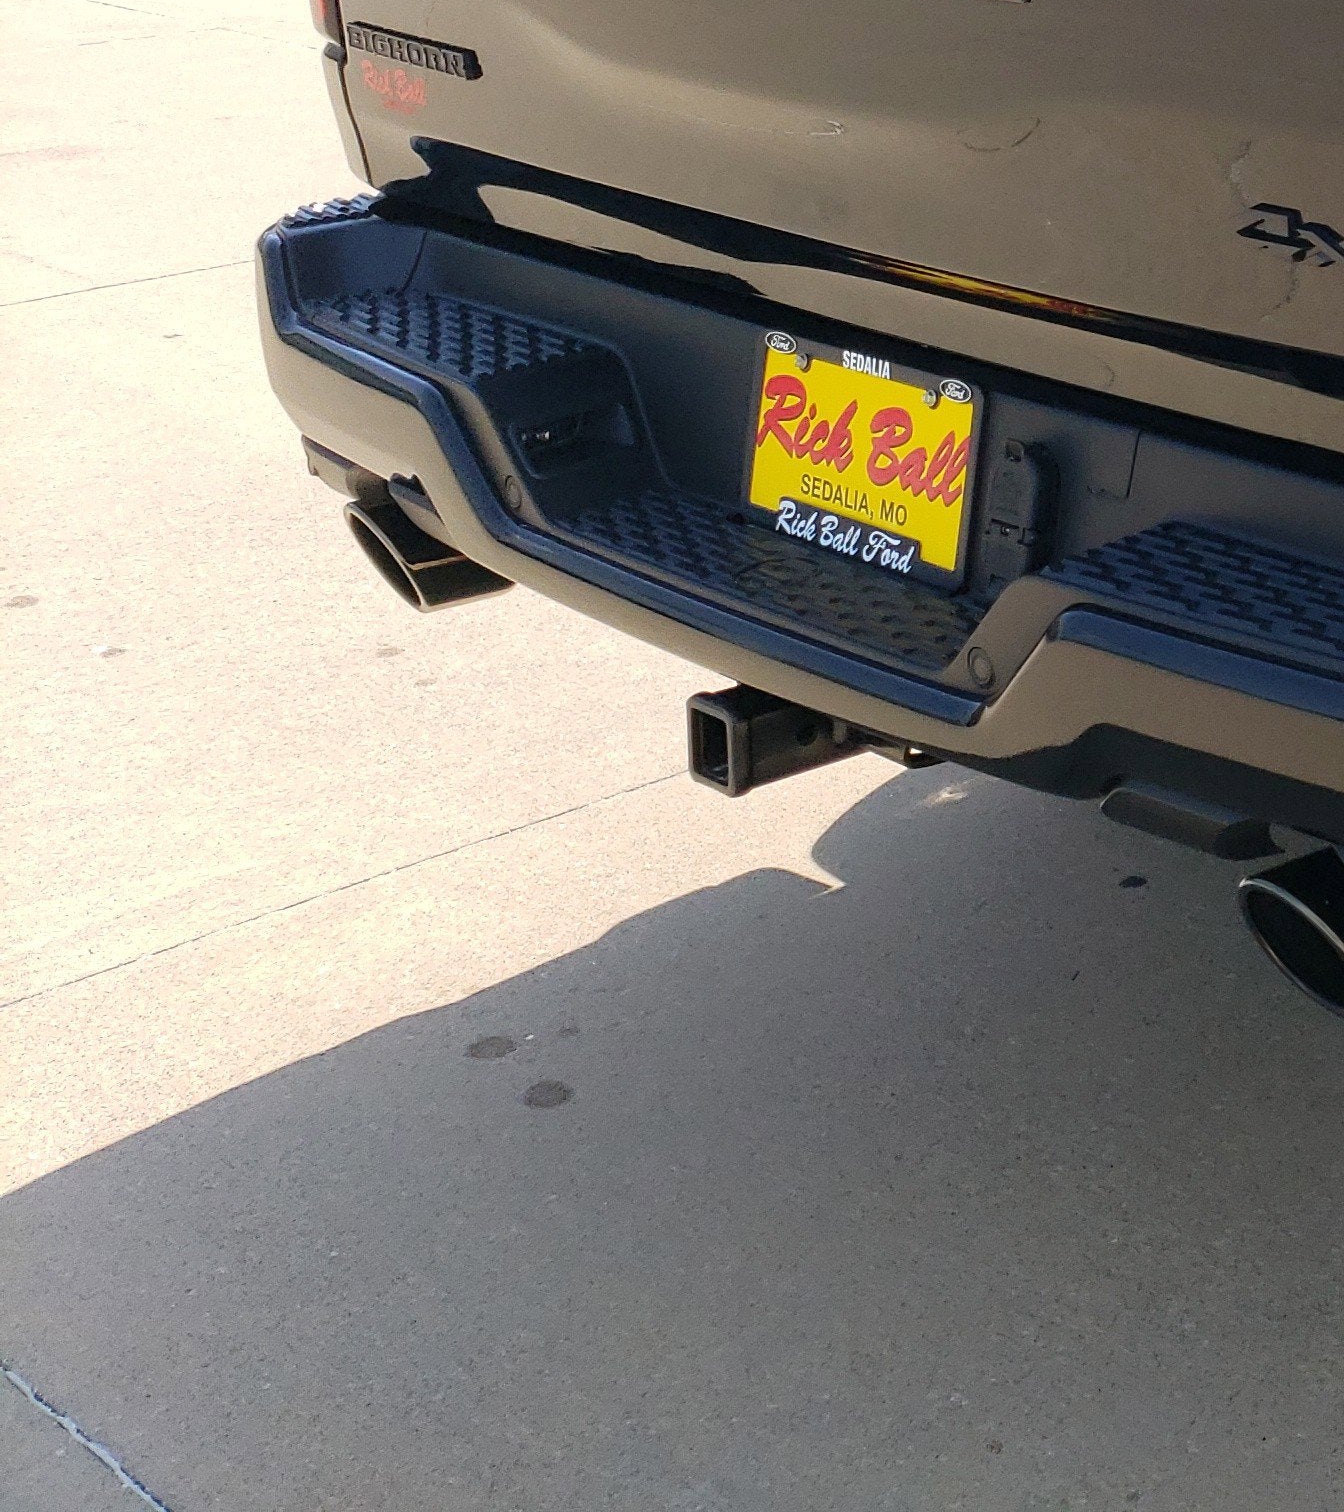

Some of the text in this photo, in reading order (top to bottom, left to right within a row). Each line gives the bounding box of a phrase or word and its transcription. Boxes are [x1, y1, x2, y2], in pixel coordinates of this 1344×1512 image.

[842, 350, 891, 380] SEDALIA
[756, 374, 972, 507] Rick Ball
[800, 473, 908, 527] SEDALIA, MO
[775, 500, 916, 574] Rick Ball Ford
